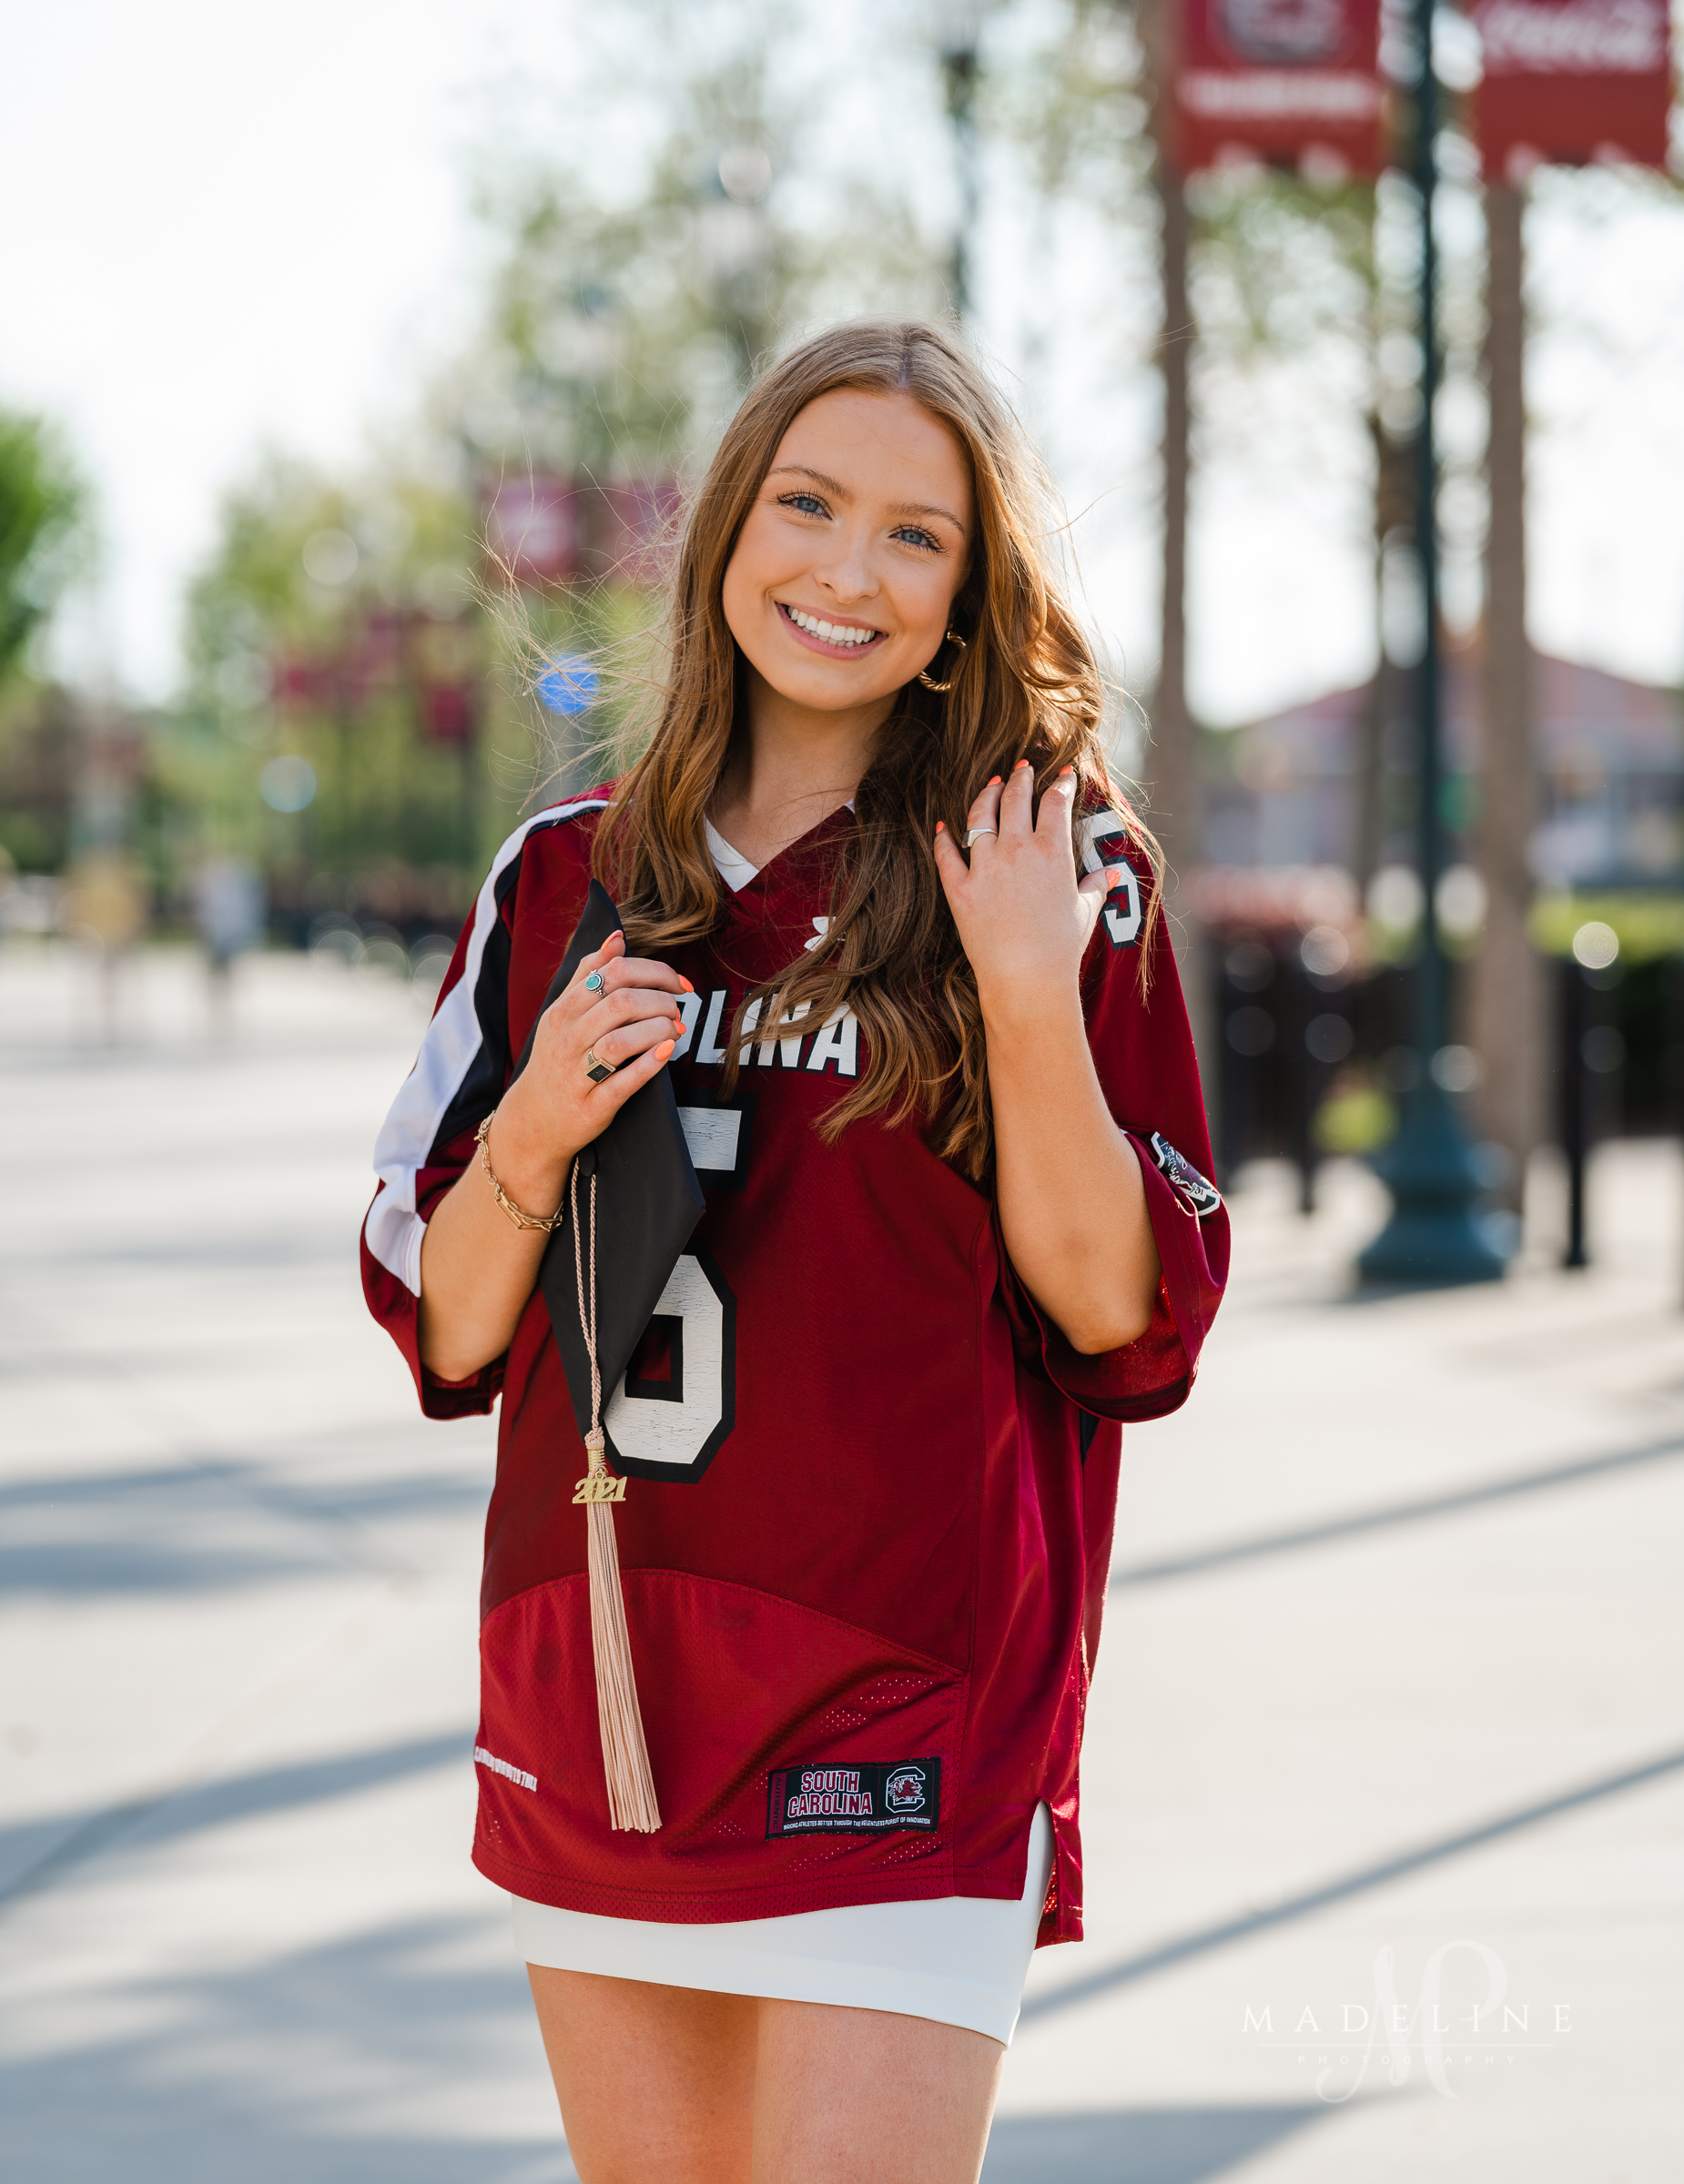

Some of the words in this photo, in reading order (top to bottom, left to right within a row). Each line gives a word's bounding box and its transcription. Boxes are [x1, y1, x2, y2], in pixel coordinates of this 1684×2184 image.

[1073, 807, 1142, 946] 5
[572, 1475, 628, 1504] 2021
[801, 1770, 860, 1793] SOUTH
[772, 1776, 782, 1830] AUTHENTIC
[787, 1792, 873, 1818] CAROLINA
[783, 1822, 798, 1831] MAKING
[861, 1819, 885, 1827] RELENTLESS
[885, 1816, 900, 1825] PURSUIT
[907, 1816, 931, 1825] INNOVATION
